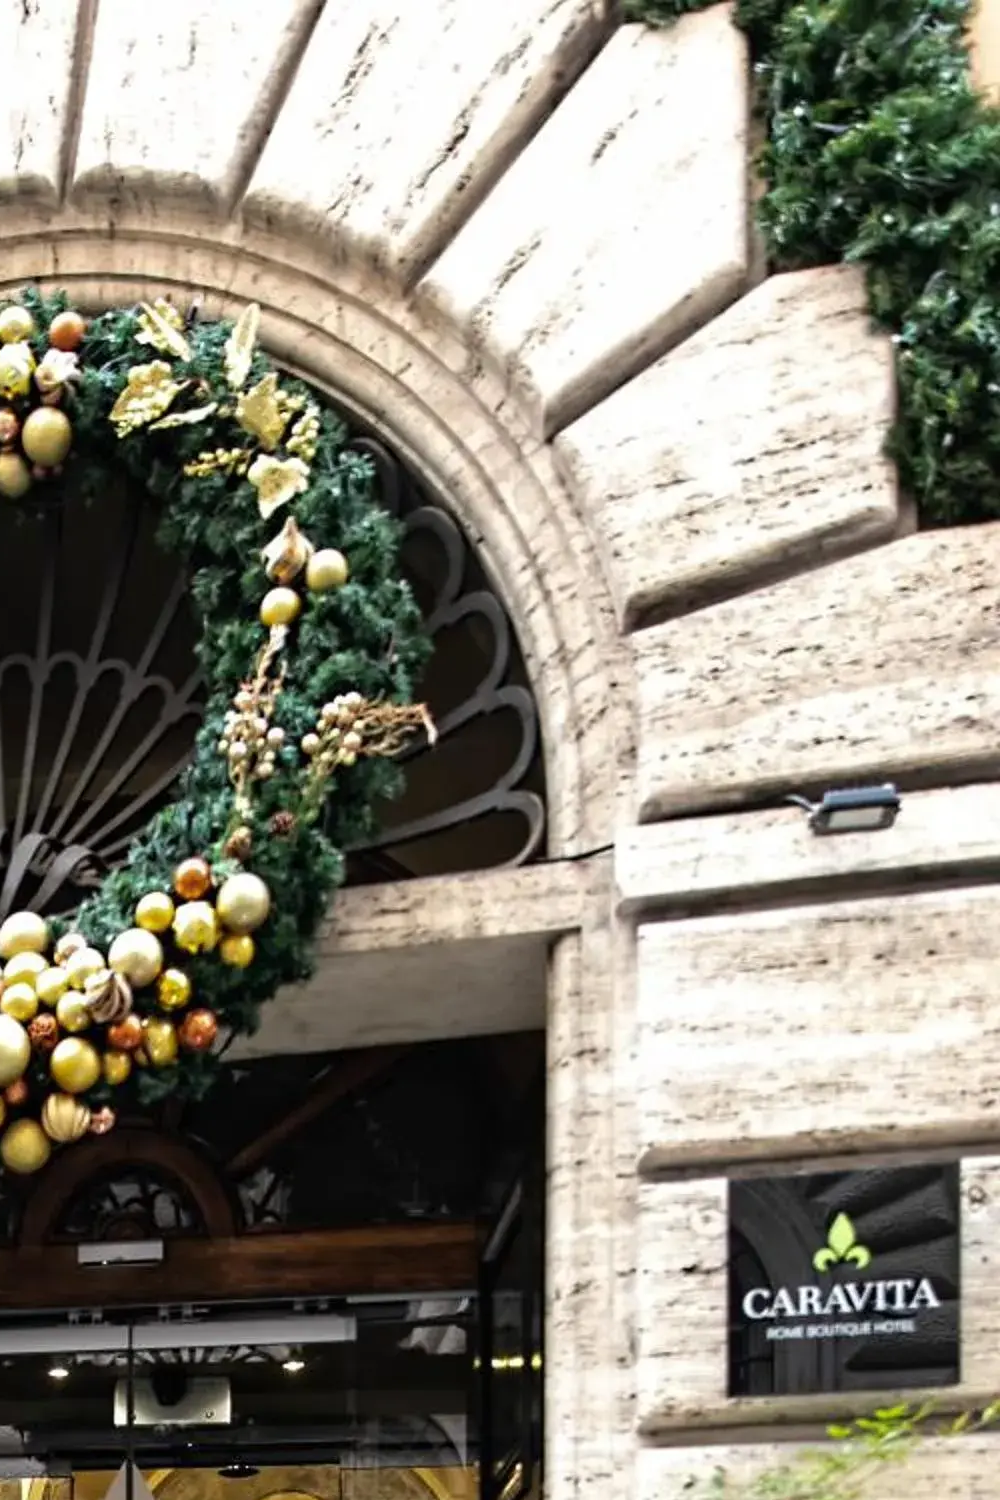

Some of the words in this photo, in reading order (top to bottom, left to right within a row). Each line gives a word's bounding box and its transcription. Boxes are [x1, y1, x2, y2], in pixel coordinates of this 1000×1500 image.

[742, 1278, 941, 1319] CARAVITA
[766, 1326, 803, 1339] ROME
[806, 1322, 872, 1337] BOUTIQUE
[873, 1319, 915, 1334] HOTEL
